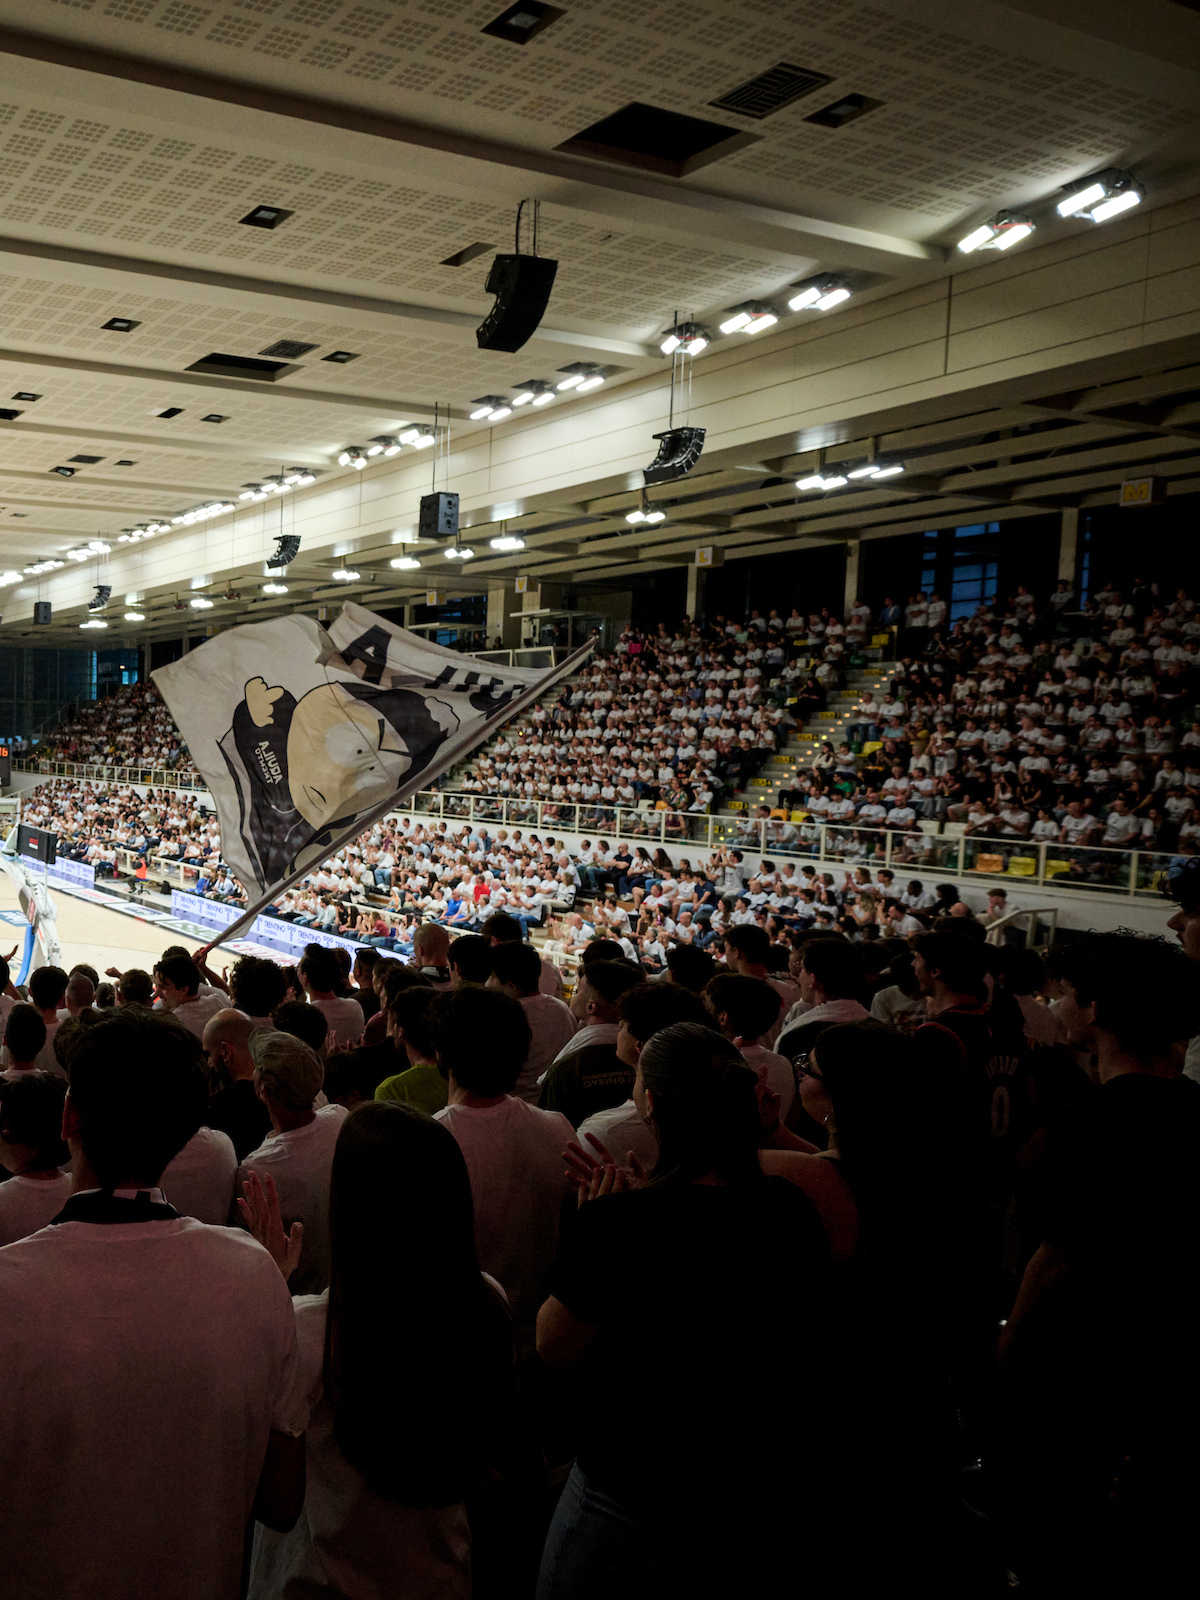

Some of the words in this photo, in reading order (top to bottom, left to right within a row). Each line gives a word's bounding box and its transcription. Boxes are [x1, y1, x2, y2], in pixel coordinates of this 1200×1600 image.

[1123, 482, 1149, 502] M
[700, 551, 707, 563] L
[518, 579, 525, 590] V
[264, 920, 285, 933] TRENTINO
[298, 930, 321, 944] TRENTINO
[990, 1085, 1010, 1138] 0
